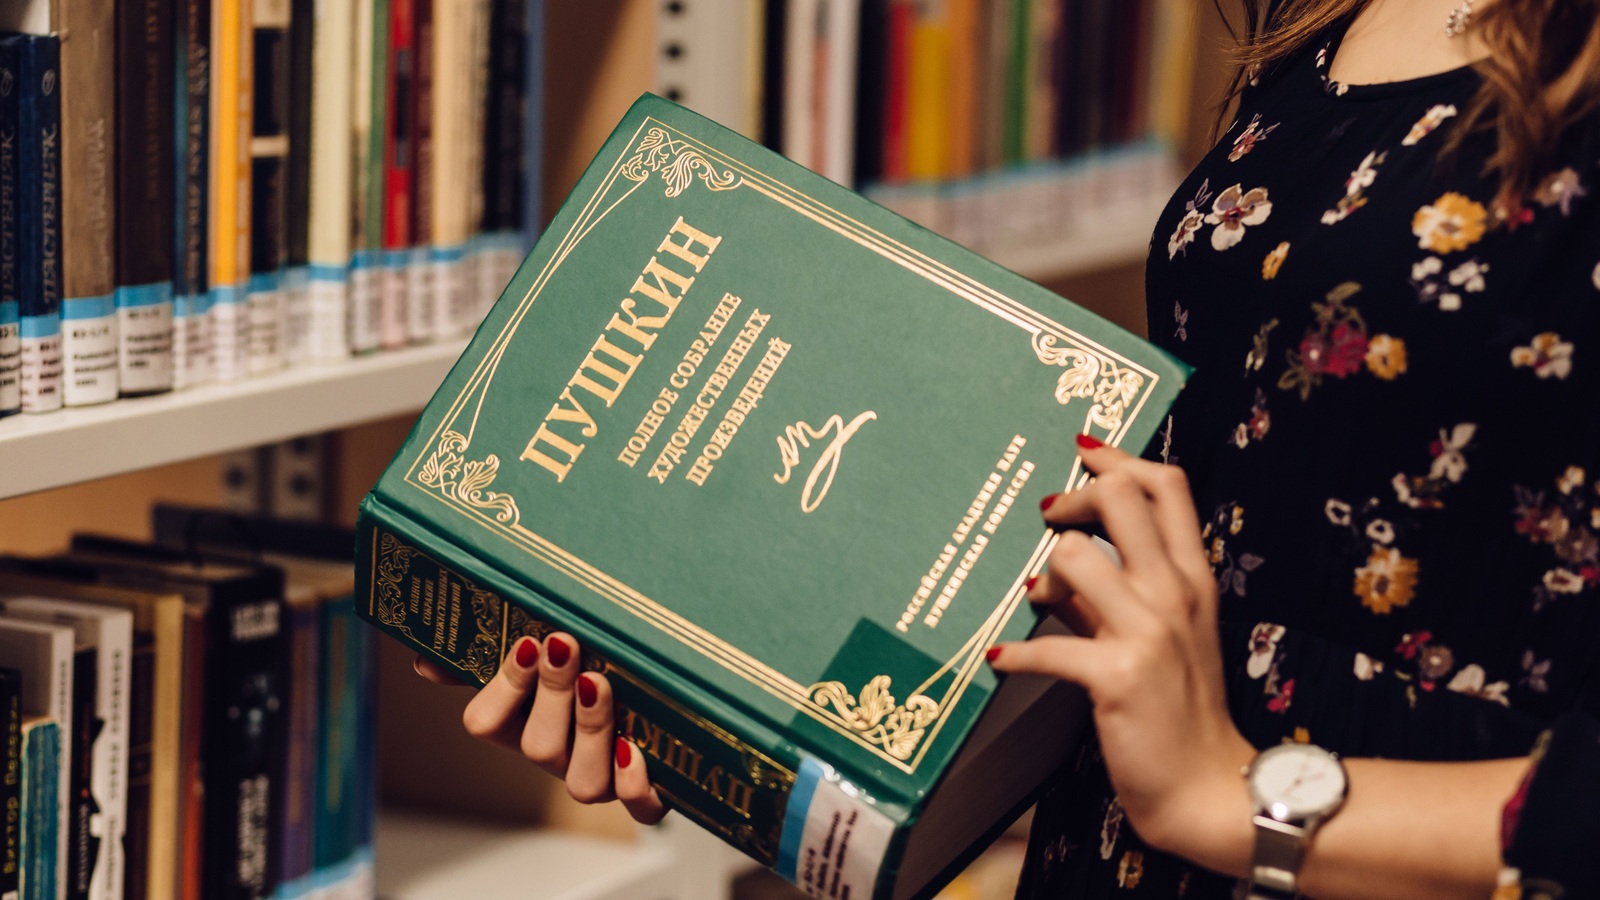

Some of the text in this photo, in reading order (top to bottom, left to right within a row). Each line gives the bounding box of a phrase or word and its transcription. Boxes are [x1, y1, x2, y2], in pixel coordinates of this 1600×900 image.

[519, 215, 723, 483] ПУШКИН
[617, 292, 742, 468] ПОЛНОЕ СОБРАНИЕ
[647, 308, 771, 485] ХУДОЖЕСТВЕННЫХ
[685, 337, 792, 486] ПРОИЗВЕДЕНИЙ
[410, 575, 421, 614] ПОЛНОЕ
[422, 578, 434, 626] СОБРАНИЕ
[434, 568, 448, 651] ХУДОЖЕСТВЕННЫХ
[896, 434, 1027, 633] РОССИЙСКАЯ АКАДЕМИЯ НАУК
[923, 460, 1035, 629] ПУШКИНСКАЯ КОМИССИЯ
[447, 582, 461, 653] ПРОИЗВЕДЕНИЙ
